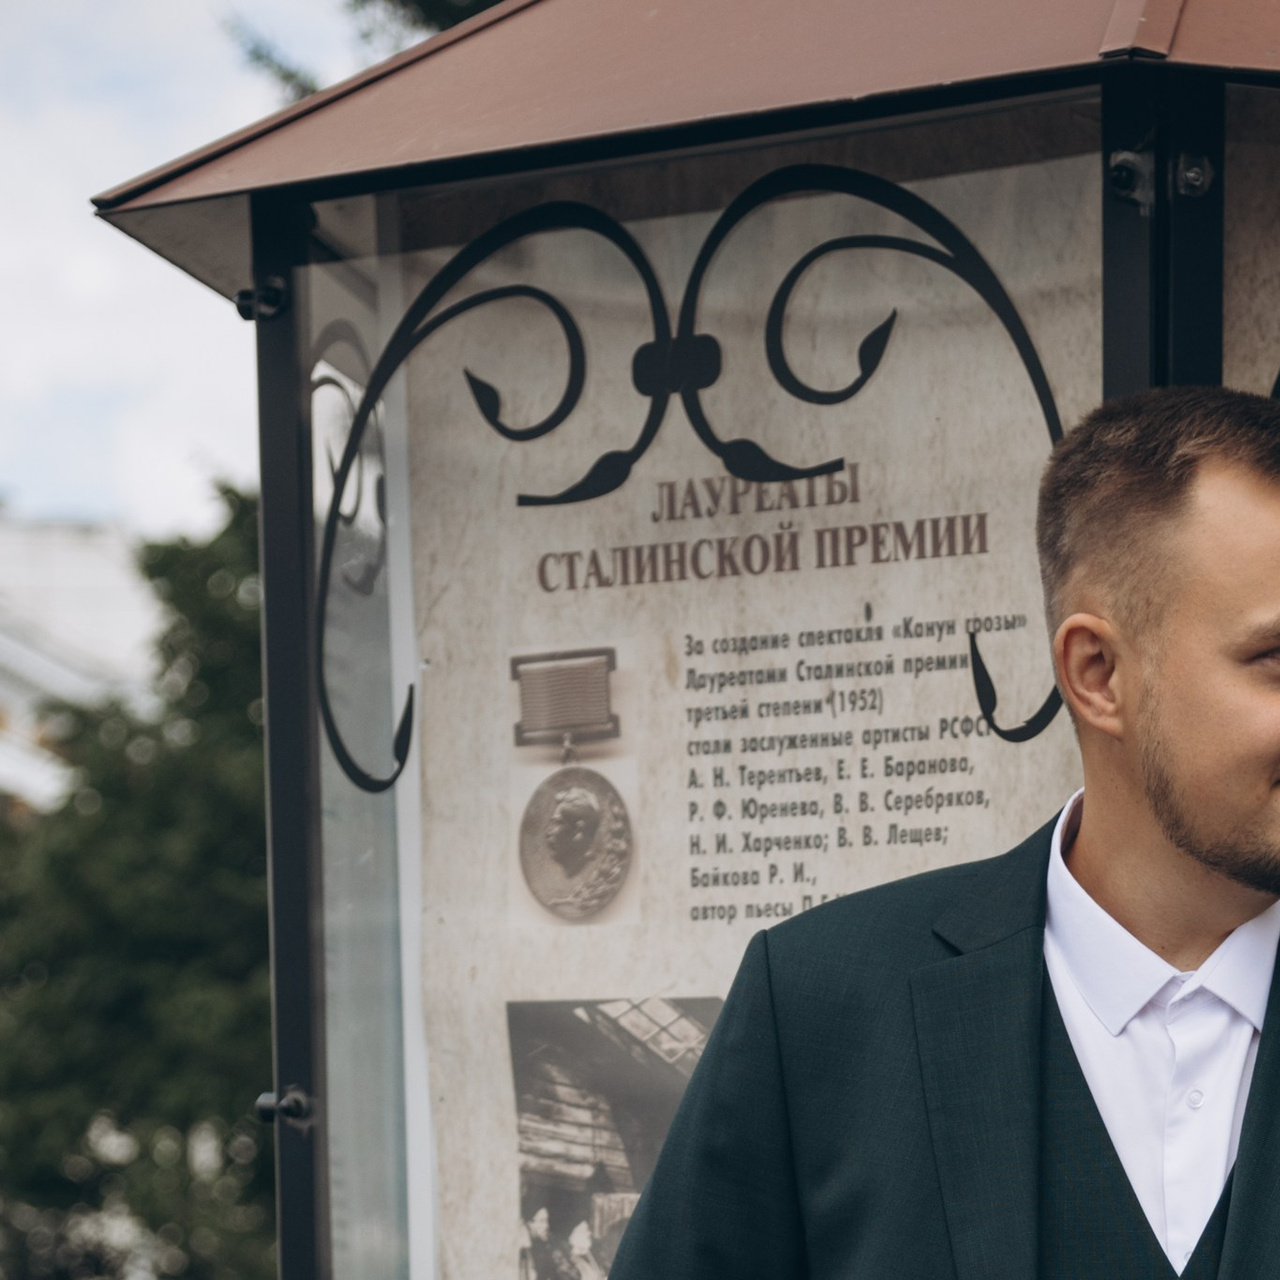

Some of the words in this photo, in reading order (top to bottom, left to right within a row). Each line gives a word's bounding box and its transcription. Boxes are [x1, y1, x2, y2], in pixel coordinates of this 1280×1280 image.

[651, 463, 860, 522] ЛАУРЕАТЫ
[538, 522, 800, 592] СТАЛИНСКОЙ
[815, 511, 989, 568] ПРЕМИИ
[684, 635, 704, 656] За
[712, 633, 790, 657] создание
[798, 624, 883, 648] спектакля
[892, 617, 955, 643] «Канун
[965, 613, 1027, 635] грозы»
[685, 667, 787, 694] Лауреатами
[796, 655, 894, 682] Сталинской
[903, 652, 969, 676] премии
[686, 700, 749, 728] третьей
[758, 698, 823, 719] степени
[830, 690, 884, 718] (1952)
[688, 736, 731, 756] стали
[740, 728, 853, 757] заслуженные
[862, 721, 930, 745] артисты
[939, 713, 990, 739] РСФС
[688, 771, 703, 789] А.
[712, 767, 730, 788] Н.
[739, 764, 827, 790] Терентьев,
[837, 759, 851, 781] Е.
[860, 758, 874, 779] Е.
[884, 755, 974, 779] Баранова,
[688, 802, 704, 822] Р.
[713, 799, 732, 820] Ф.
[833, 794, 849, 814] В.
[859, 792, 874, 813] В.
[884, 787, 991, 816] Серебряков,
[690, 834, 706, 855] Н.
[716, 833, 733, 853] И.
[742, 831, 828, 857] Харченко;
[837, 827, 852, 848] В.
[862, 825, 878, 846] В.
[886, 824, 949, 847] Лещев;
[690, 866, 760, 888] Байкова
[769, 864, 784, 884] Р.
[793, 862, 817, 886] И.,
[690, 902, 737, 924] автор
[745, 900, 793, 919] пьесы
